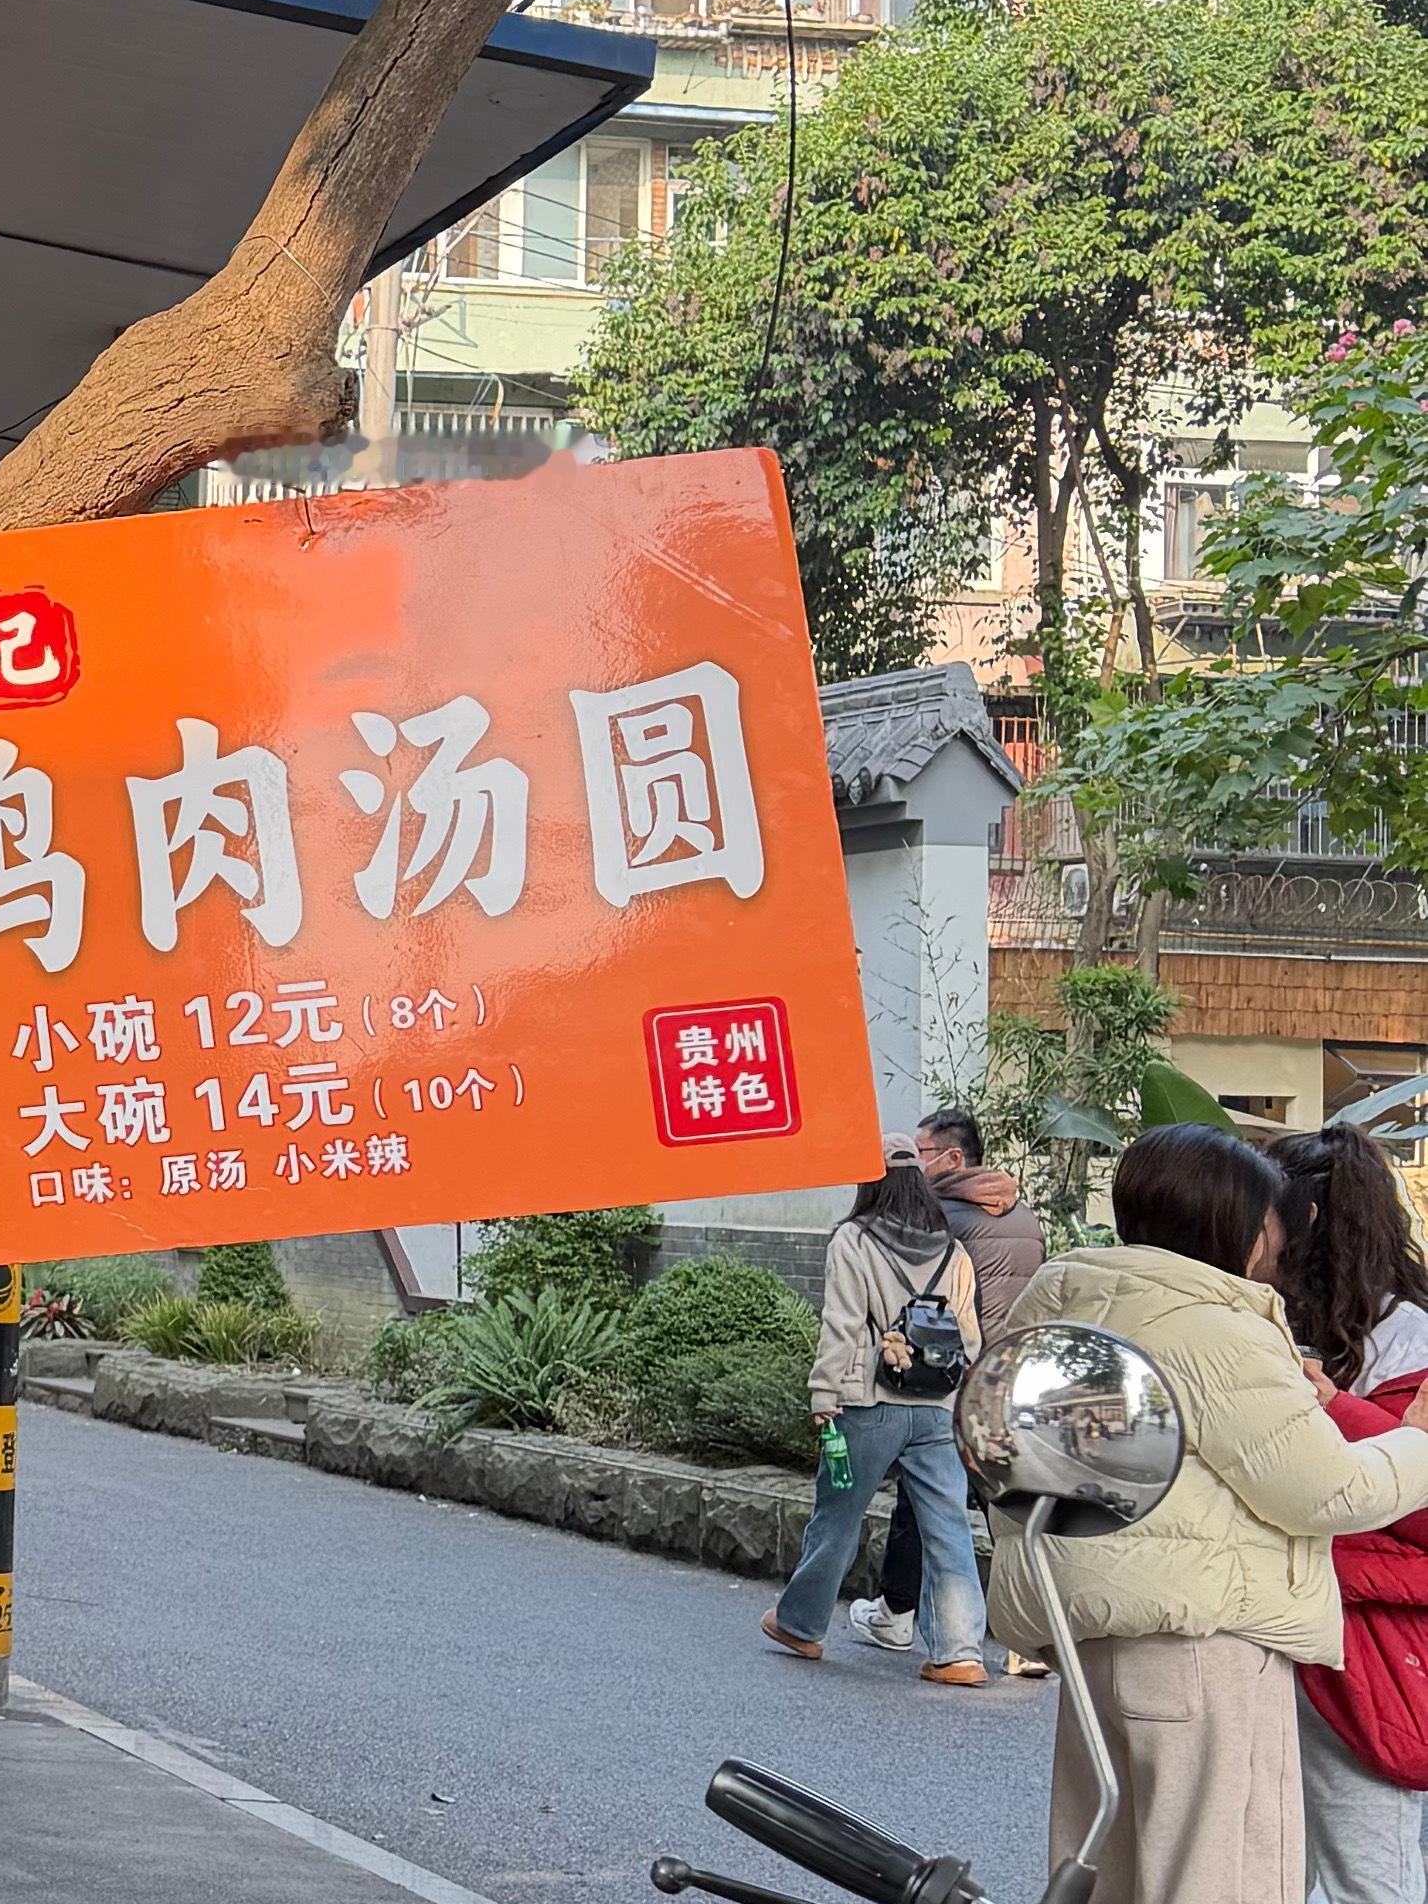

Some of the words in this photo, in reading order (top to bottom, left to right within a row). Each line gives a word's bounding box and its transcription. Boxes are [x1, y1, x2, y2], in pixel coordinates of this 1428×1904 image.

[11, 994, 162, 1072] 小碗
[183, 980, 345, 1050] 12元
[675, 1018, 766, 1070] 贵州
[18, 1076, 172, 1158] 大碗
[194, 1061, 356, 1133] 14元
[681, 1071, 776, 1119] 特色
[160, 1149, 247, 1197] 原汤
[274, 1132, 412, 1185] 小米辣
